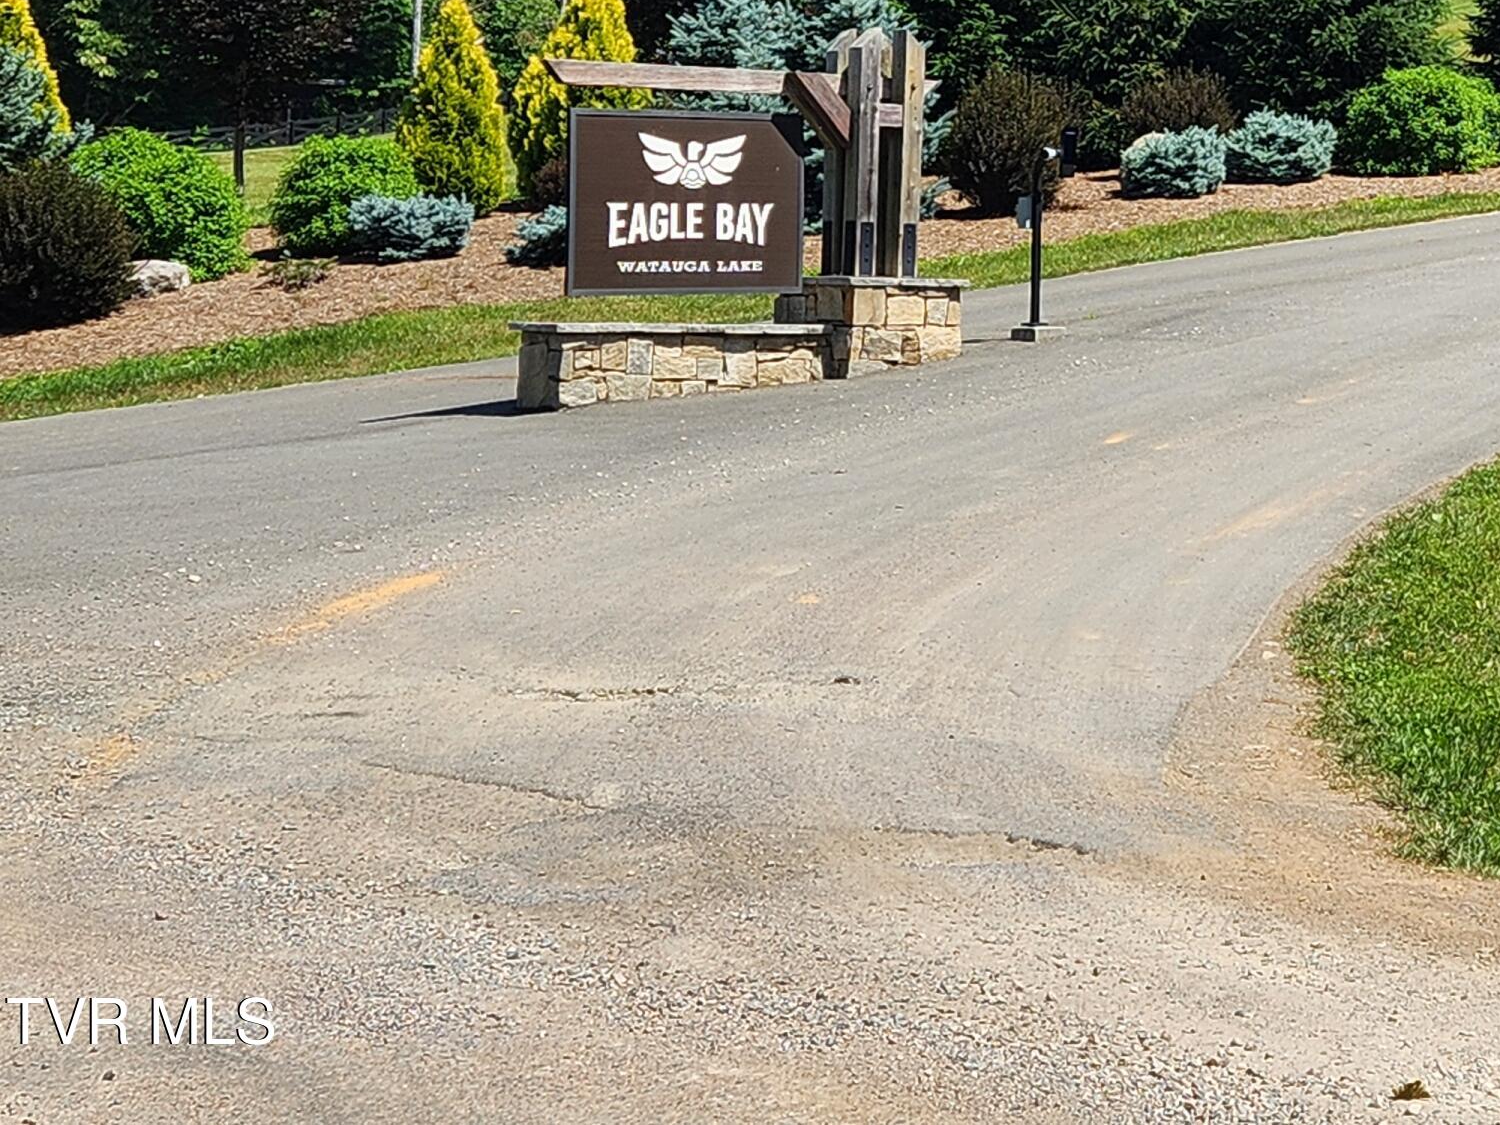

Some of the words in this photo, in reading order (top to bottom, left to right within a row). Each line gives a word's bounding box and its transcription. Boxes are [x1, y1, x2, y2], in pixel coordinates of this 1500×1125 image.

[607, 202, 704, 248] EAGLE
[716, 202, 774, 247] BAY
[617, 261, 711, 273] WATAUGA
[717, 261, 763, 272] LAKE
